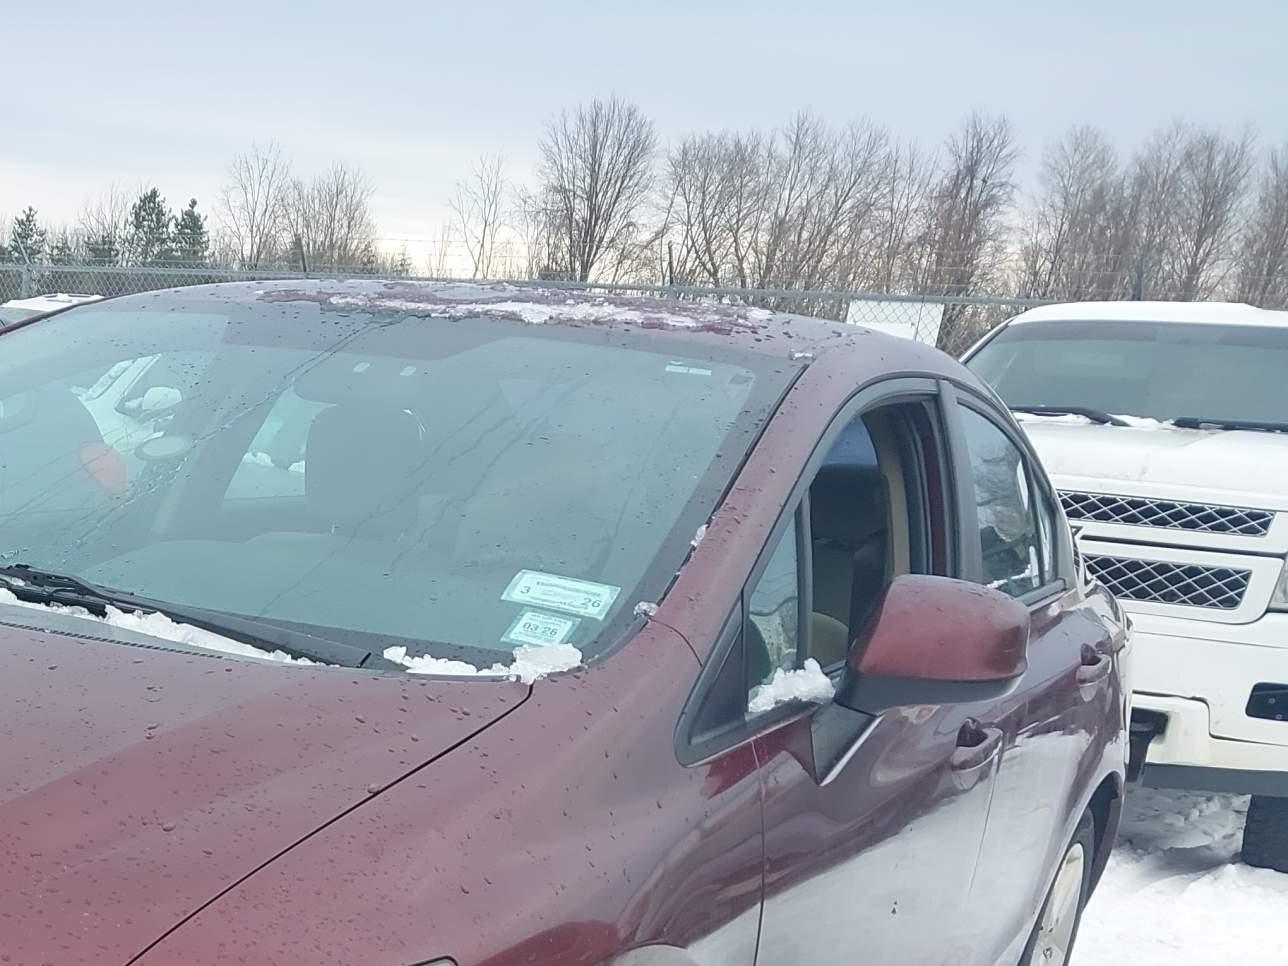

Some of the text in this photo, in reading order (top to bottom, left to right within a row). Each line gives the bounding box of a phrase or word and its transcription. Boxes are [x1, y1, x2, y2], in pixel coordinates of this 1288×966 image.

[519, 585, 532, 595] 3
[580, 597, 602, 608] 26
[522, 622, 540, 631] 03
